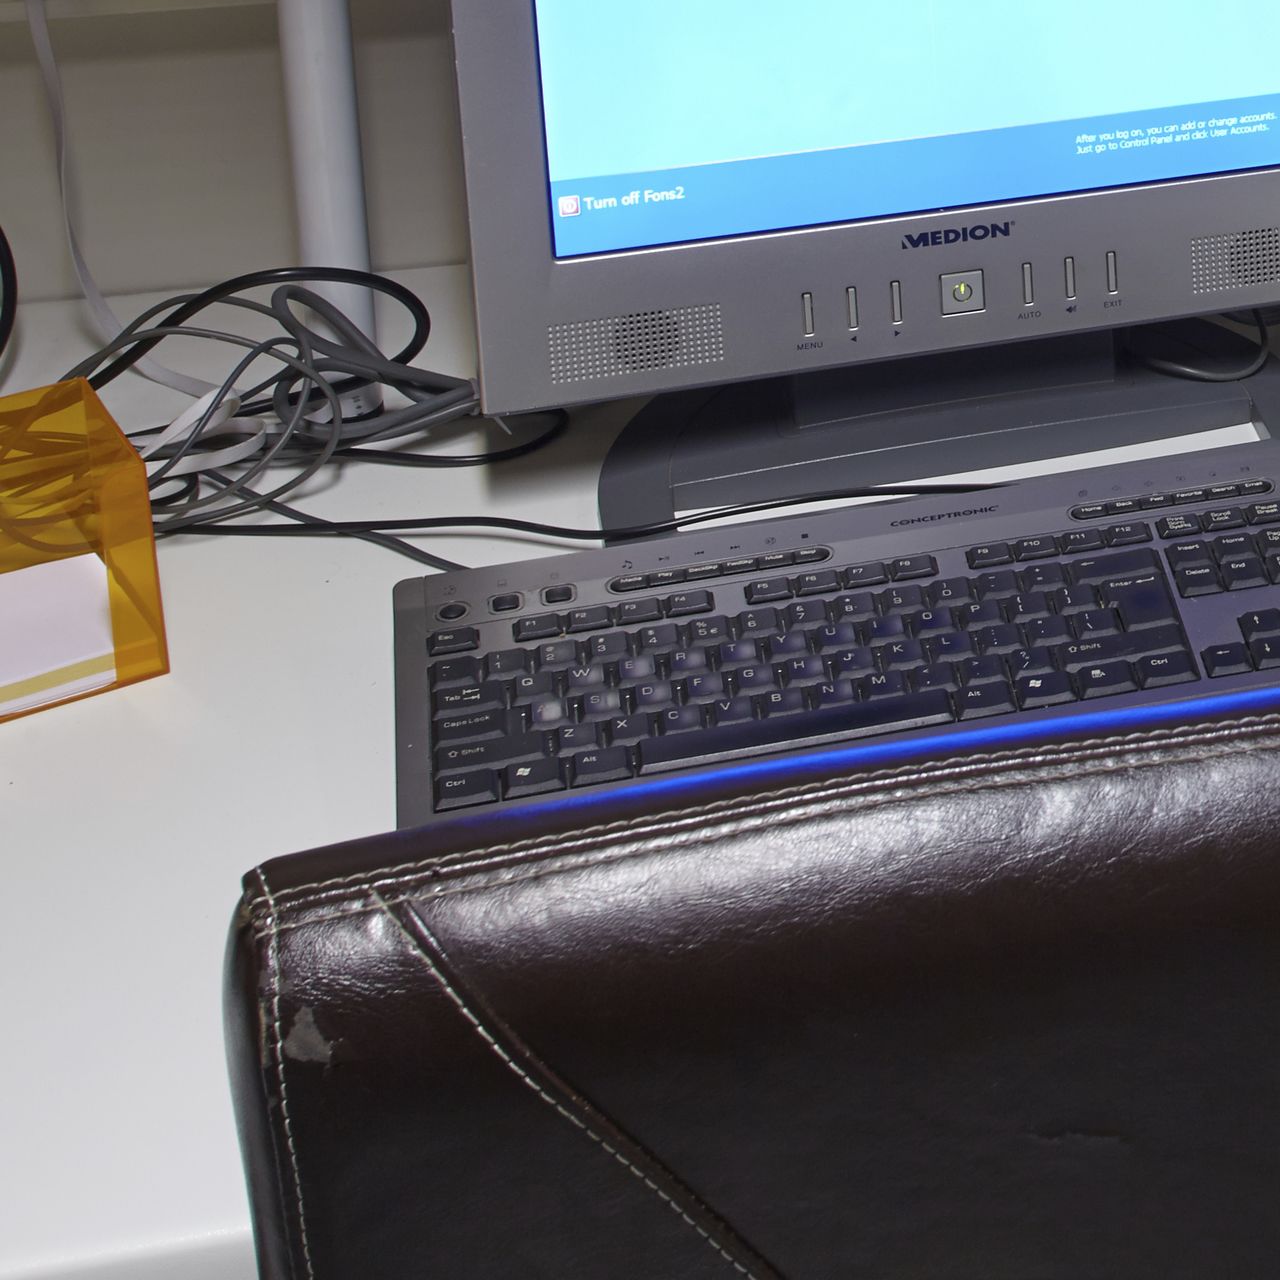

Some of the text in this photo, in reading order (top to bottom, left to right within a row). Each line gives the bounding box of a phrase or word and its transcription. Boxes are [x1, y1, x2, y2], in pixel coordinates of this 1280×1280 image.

[1075, 111, 1278, 145] After you log on, you can add or change accounts.
[1076, 122, 1270, 155] Just go to Control Panel and click User Accounts.
[583, 186, 686, 211] Turn off Fons2
[901, 222, 1011, 249] MEDION
[1103, 300, 1123, 308] EXIT
[1018, 310, 1042, 320] AUTO
[796, 341, 824, 351] MENU
[1211, 485, 1236, 493] Search
[1176, 490, 1203, 498] Favorite
[1081, 505, 1102, 513] Home
[890, 505, 998, 527] CONCEPTRONIC
[1070, 533, 1085, 541] F11
[1222, 536, 1245, 544] Home
[1177, 543, 1200, 551] Insert
[1185, 568, 1210, 576] Delete
[1110, 579, 1133, 588] Enter
[893, 596, 902, 604] 9
[970, 604, 980, 612] P
[922, 612, 932, 620] O
[648, 636, 657, 644] 4
[777, 635, 786, 644] Y
[597, 644, 606, 652] 3
[728, 644, 736, 652] T
[893, 644, 903, 652] K
[1080, 642, 1101, 651] Shift
[676, 652, 686, 660] R
[843, 654, 852, 662] J
[495, 661, 500, 669] 1
[625, 660, 633, 669] E
[793, 661, 805, 669] H
[1151, 657, 1168, 666] Ctrl
[572, 668, 590, 678] W
[521, 678, 533, 687] Q
[694, 678, 702, 686] F
[872, 675, 886, 684] M
[642, 687, 652, 695] D
[590, 695, 600, 704] S
[771, 694, 782, 702] B
[720, 702, 730, 710] V
[668, 711, 678, 719] C
[444, 715, 490, 729] Caps Lock
[617, 720, 627, 728] X
[564, 729, 574, 737] Z
[461, 746, 485, 756] Shift
[583, 755, 597, 763] Alt
[446, 779, 466, 788] Ctrl
